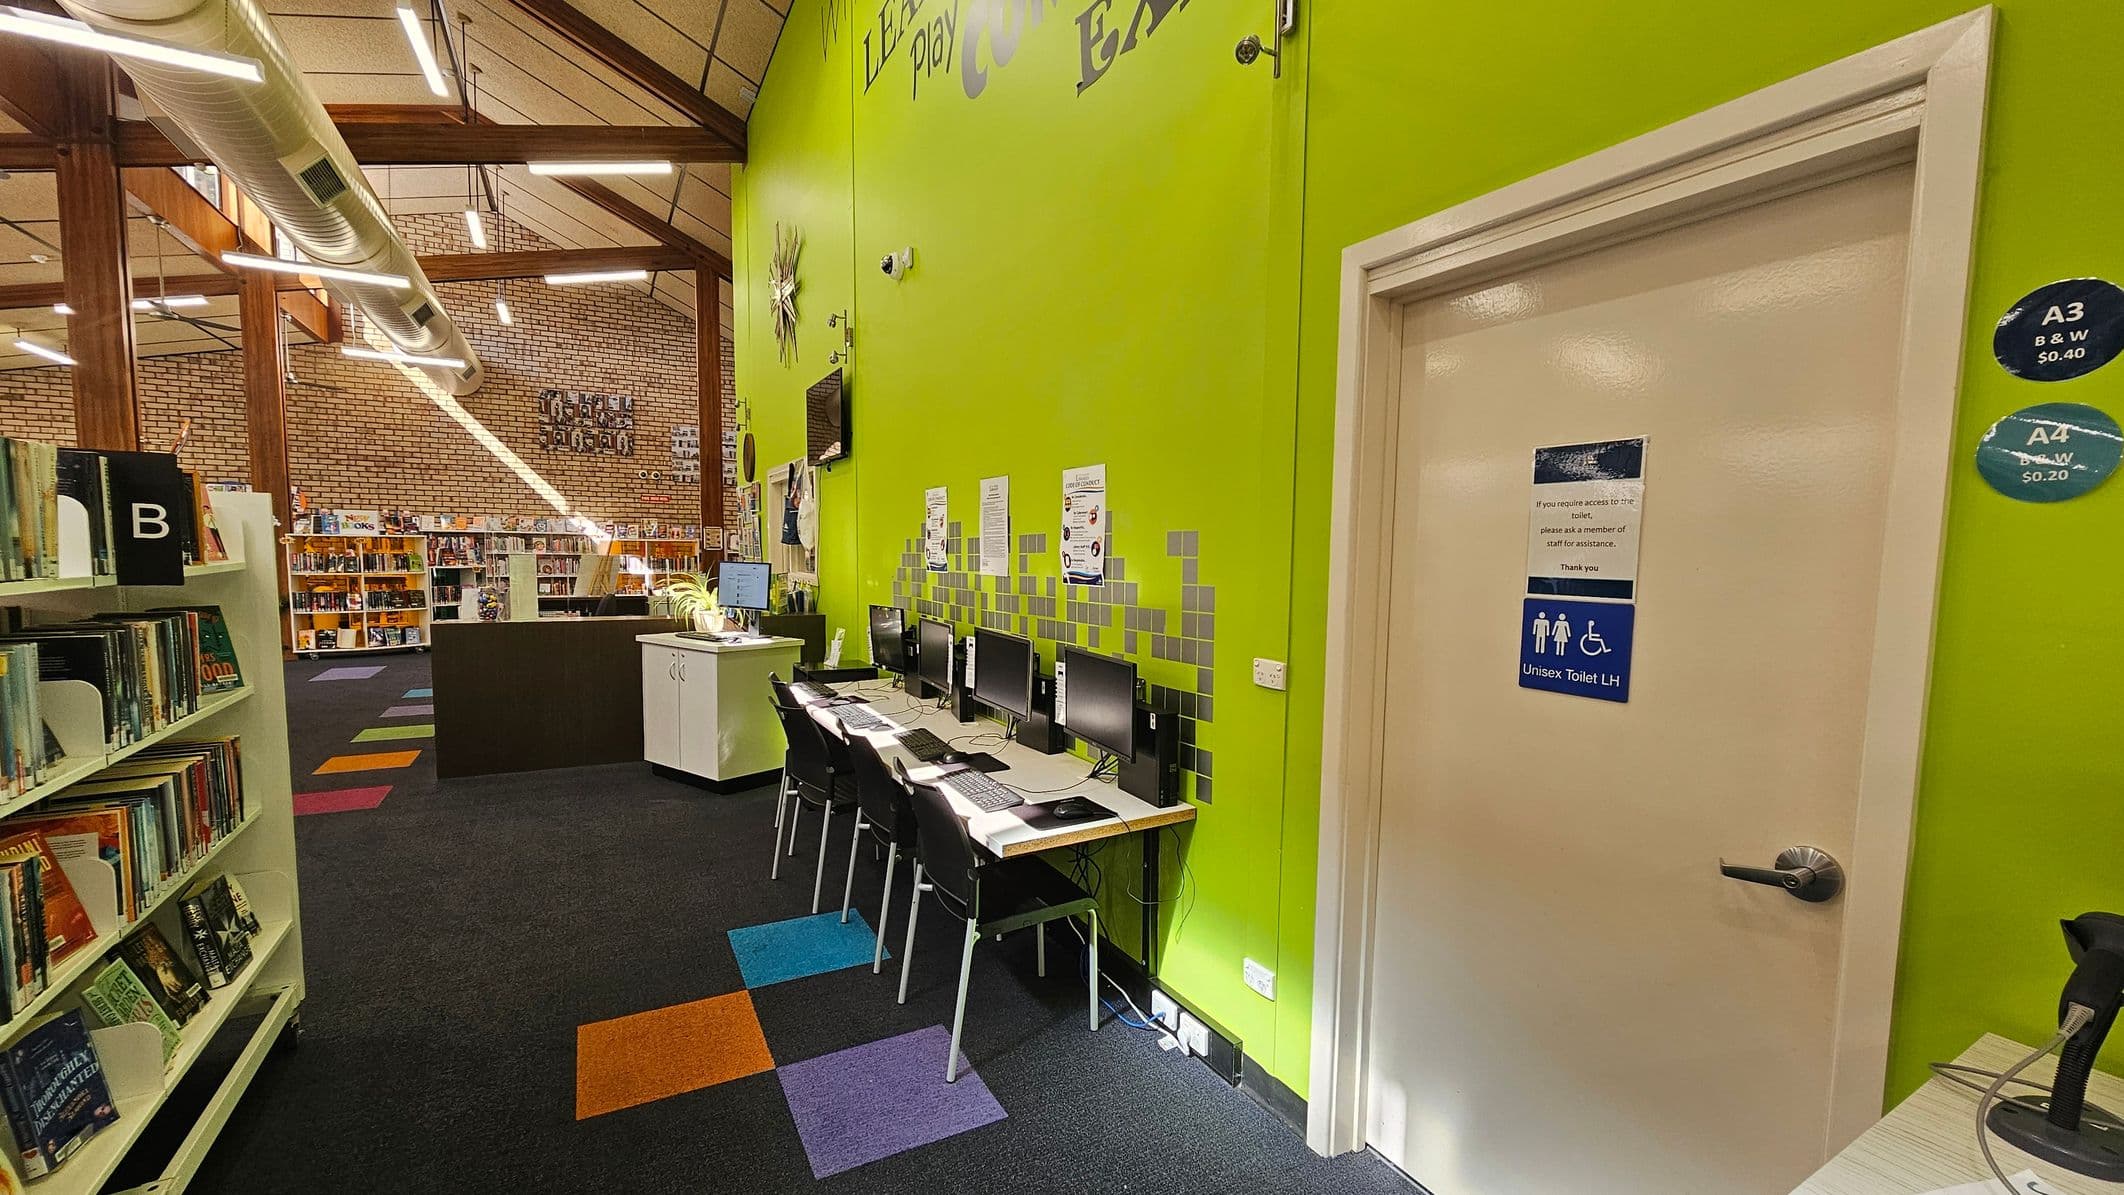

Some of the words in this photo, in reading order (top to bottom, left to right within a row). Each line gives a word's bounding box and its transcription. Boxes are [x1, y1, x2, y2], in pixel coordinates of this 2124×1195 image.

[910, 0, 958, 101] play
[2041, 301, 2084, 326] A3
[2035, 336, 2046, 347] B
[2050, 333, 2064, 345] &
[2069, 329, 2089, 342] W
[2037, 347, 2086, 365] $0.40
[2026, 424, 2070, 446] A4
[2020, 454, 2031, 466] B
[2035, 454, 2050, 465] &
[2054, 452, 2074, 464] W
[2022, 469, 2069, 484] $0.20
[1542, 502, 1556, 510] you
[1557, 499, 1583, 509] require
[1620, 497, 1635, 505] the
[131, 502, 170, 539] B
[1571, 511, 1593, 520] toilet,
[1540, 526, 1563, 536] please
[1564, 526, 1576, 534] ask
[1583, 526, 1616, 534] member
[1617, 525, 1626, 533] of
[1546, 539, 1563, 547] staff
[1564, 539, 1574, 547] for
[1575, 540, 1617, 548] assistance.
[1560, 563, 1583, 571] Thank
[1584, 565, 1599, 573] you
[1523, 663, 1562, 679] Unisex
[1565, 668, 1598, 684] Toilet
[1601, 673, 1620, 688] LH
[29, 1049, 91, 1118] THOROUGHLY
[33, 1062, 100, 1135] DISENCHANTED
